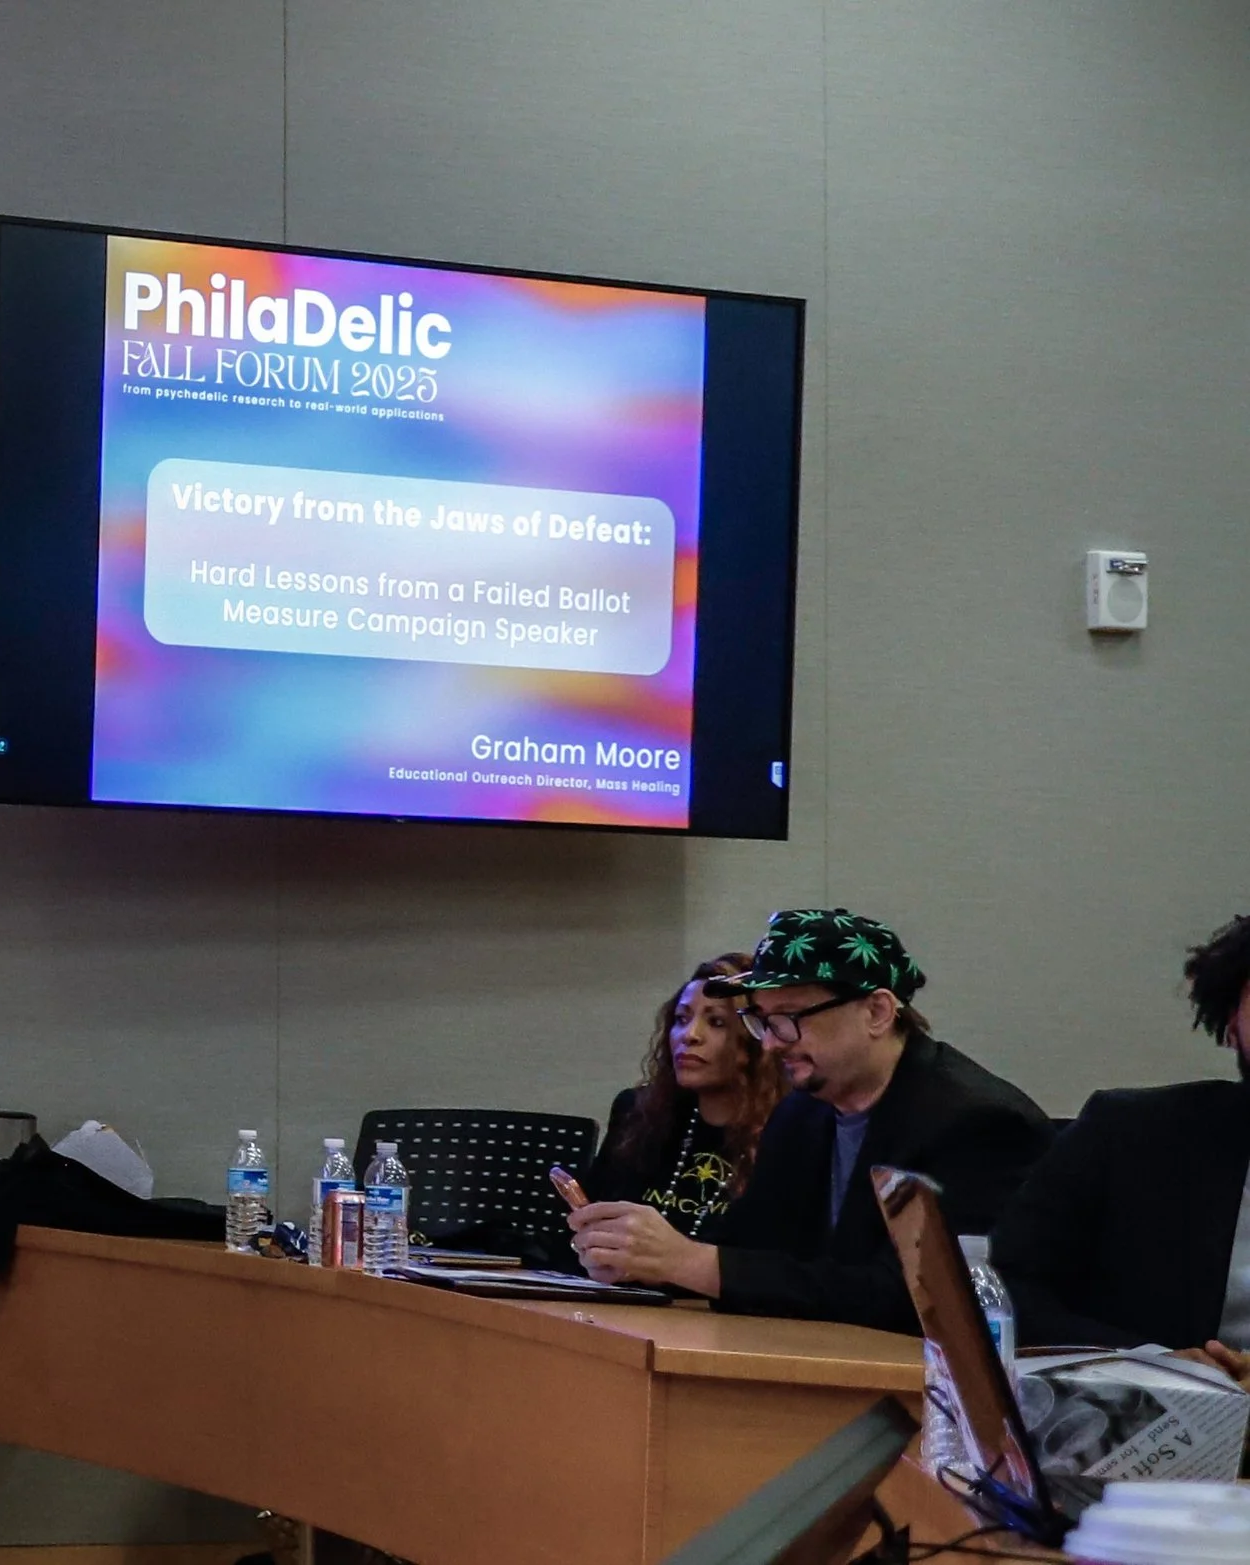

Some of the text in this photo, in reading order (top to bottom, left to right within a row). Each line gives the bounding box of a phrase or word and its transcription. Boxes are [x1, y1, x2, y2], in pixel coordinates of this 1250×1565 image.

[123, 271, 452, 359] PhilaDelic
[122, 340, 438, 403] FALL FORUM 2025
[123, 383, 445, 422] from psychedelic research to real-world applications
[172, 483, 652, 545] Victory from the Jaws of Defeat:
[191, 561, 630, 614] Hard Lessons from a Failed Ballot
[223, 599, 598, 648] Measure Campaign Speaker
[471, 735, 680, 769] Graham Moore
[389, 767, 680, 796] Educational Outreach Director, Mass Healing
[1173, 1427, 1193, 1447] A
[1130, 1443, 1177, 1477] Soft
